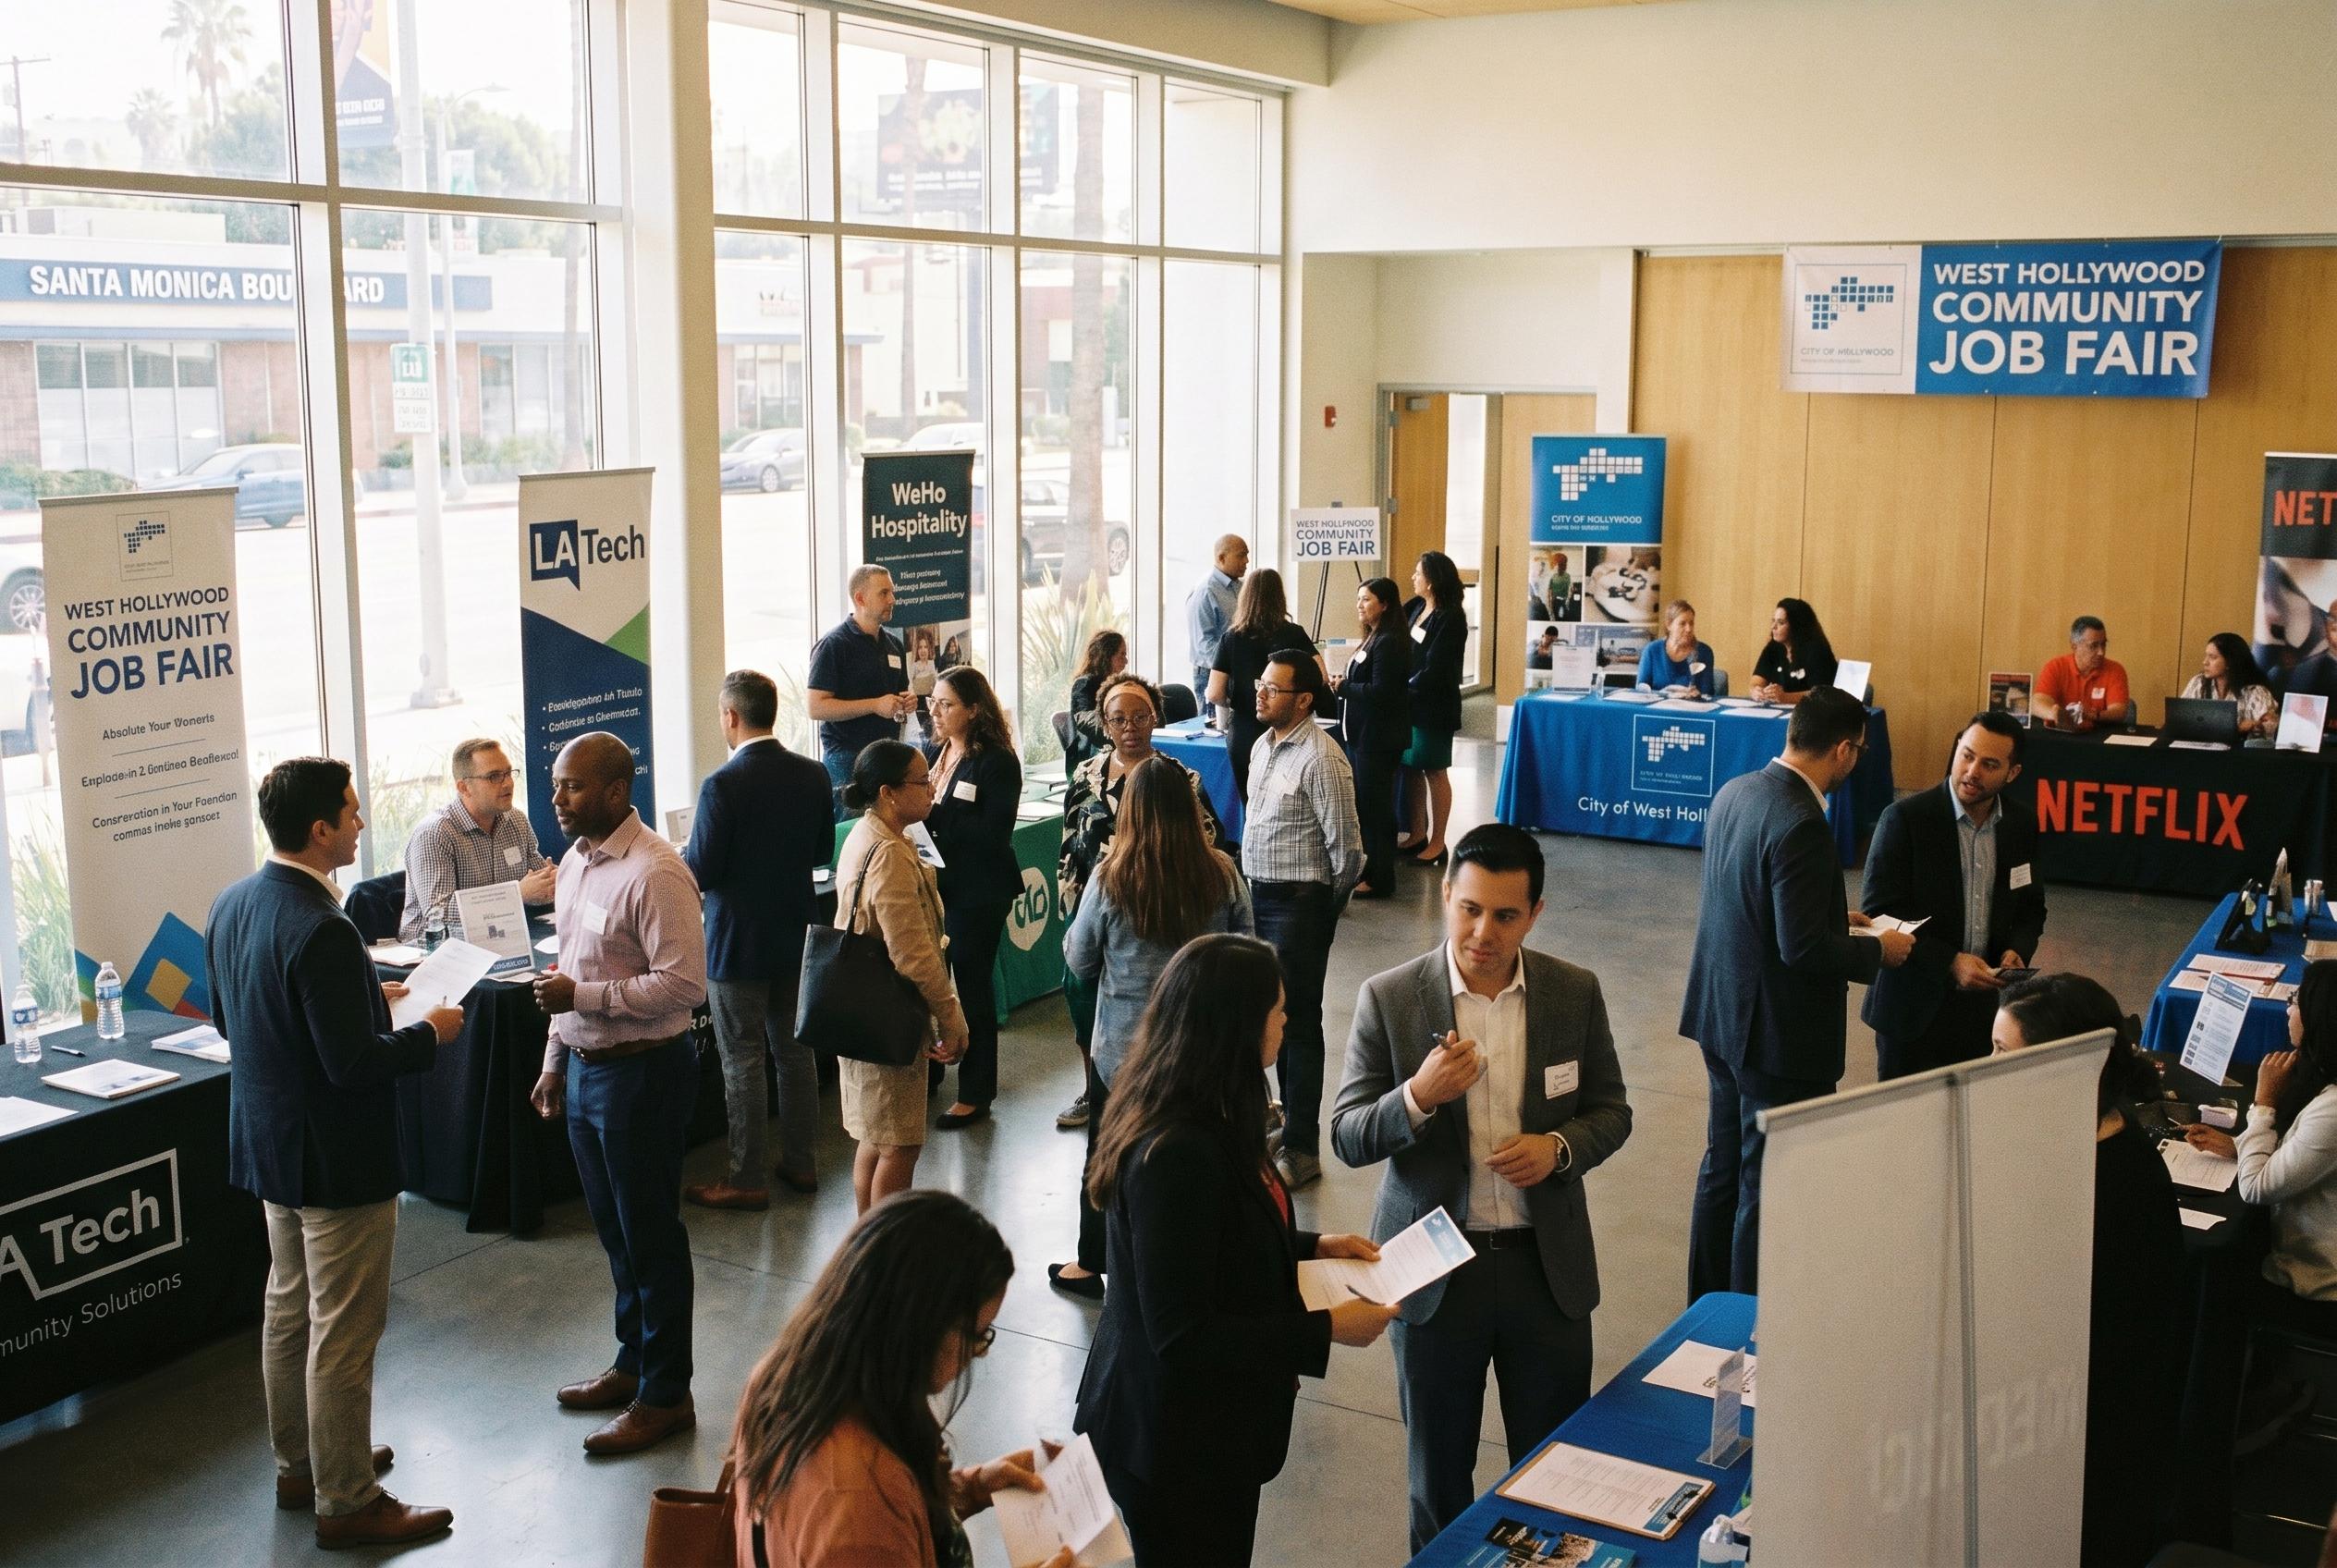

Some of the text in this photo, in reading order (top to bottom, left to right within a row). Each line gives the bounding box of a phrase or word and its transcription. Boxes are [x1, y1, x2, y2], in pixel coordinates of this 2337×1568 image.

[29, 265, 385, 303] SANTA MONICA BOUARD
[1933, 260, 2206, 285] WEST HOLLYWOOD
[1932, 289, 2204, 323] COMMUNITY
[1928, 329, 2199, 376] JOB FAIR
[891, 481, 947, 506] WeHo
[872, 508, 968, 543] Hospitality
[1296, 529, 1374, 540] COMMUNITY
[1551, 515, 1572, 523] CITY
[1572, 515, 1585, 523] OF
[534, 524, 645, 571] LA Tech
[1297, 541, 1375, 557] JOB FAIR
[65, 586, 229, 620] WEST HOLLYWOOD
[67, 610, 230, 654] COMMUNITY
[70, 643, 235, 699] JOB FAIR
[103, 725, 146, 741] Absolute
[148, 721, 171, 732] Your
[139, 766, 146, 777] 2
[161, 803, 170, 814] in
[172, 800, 193, 811] Your
[1578, 796, 1609, 817] City
[1612, 800, 1630, 815] of
[1633, 802, 1671, 819] West
[2037, 778, 2249, 851] NETFLIX
[40, 1188, 161, 1265] Tech
[81, 1272, 182, 1324] Solutions
